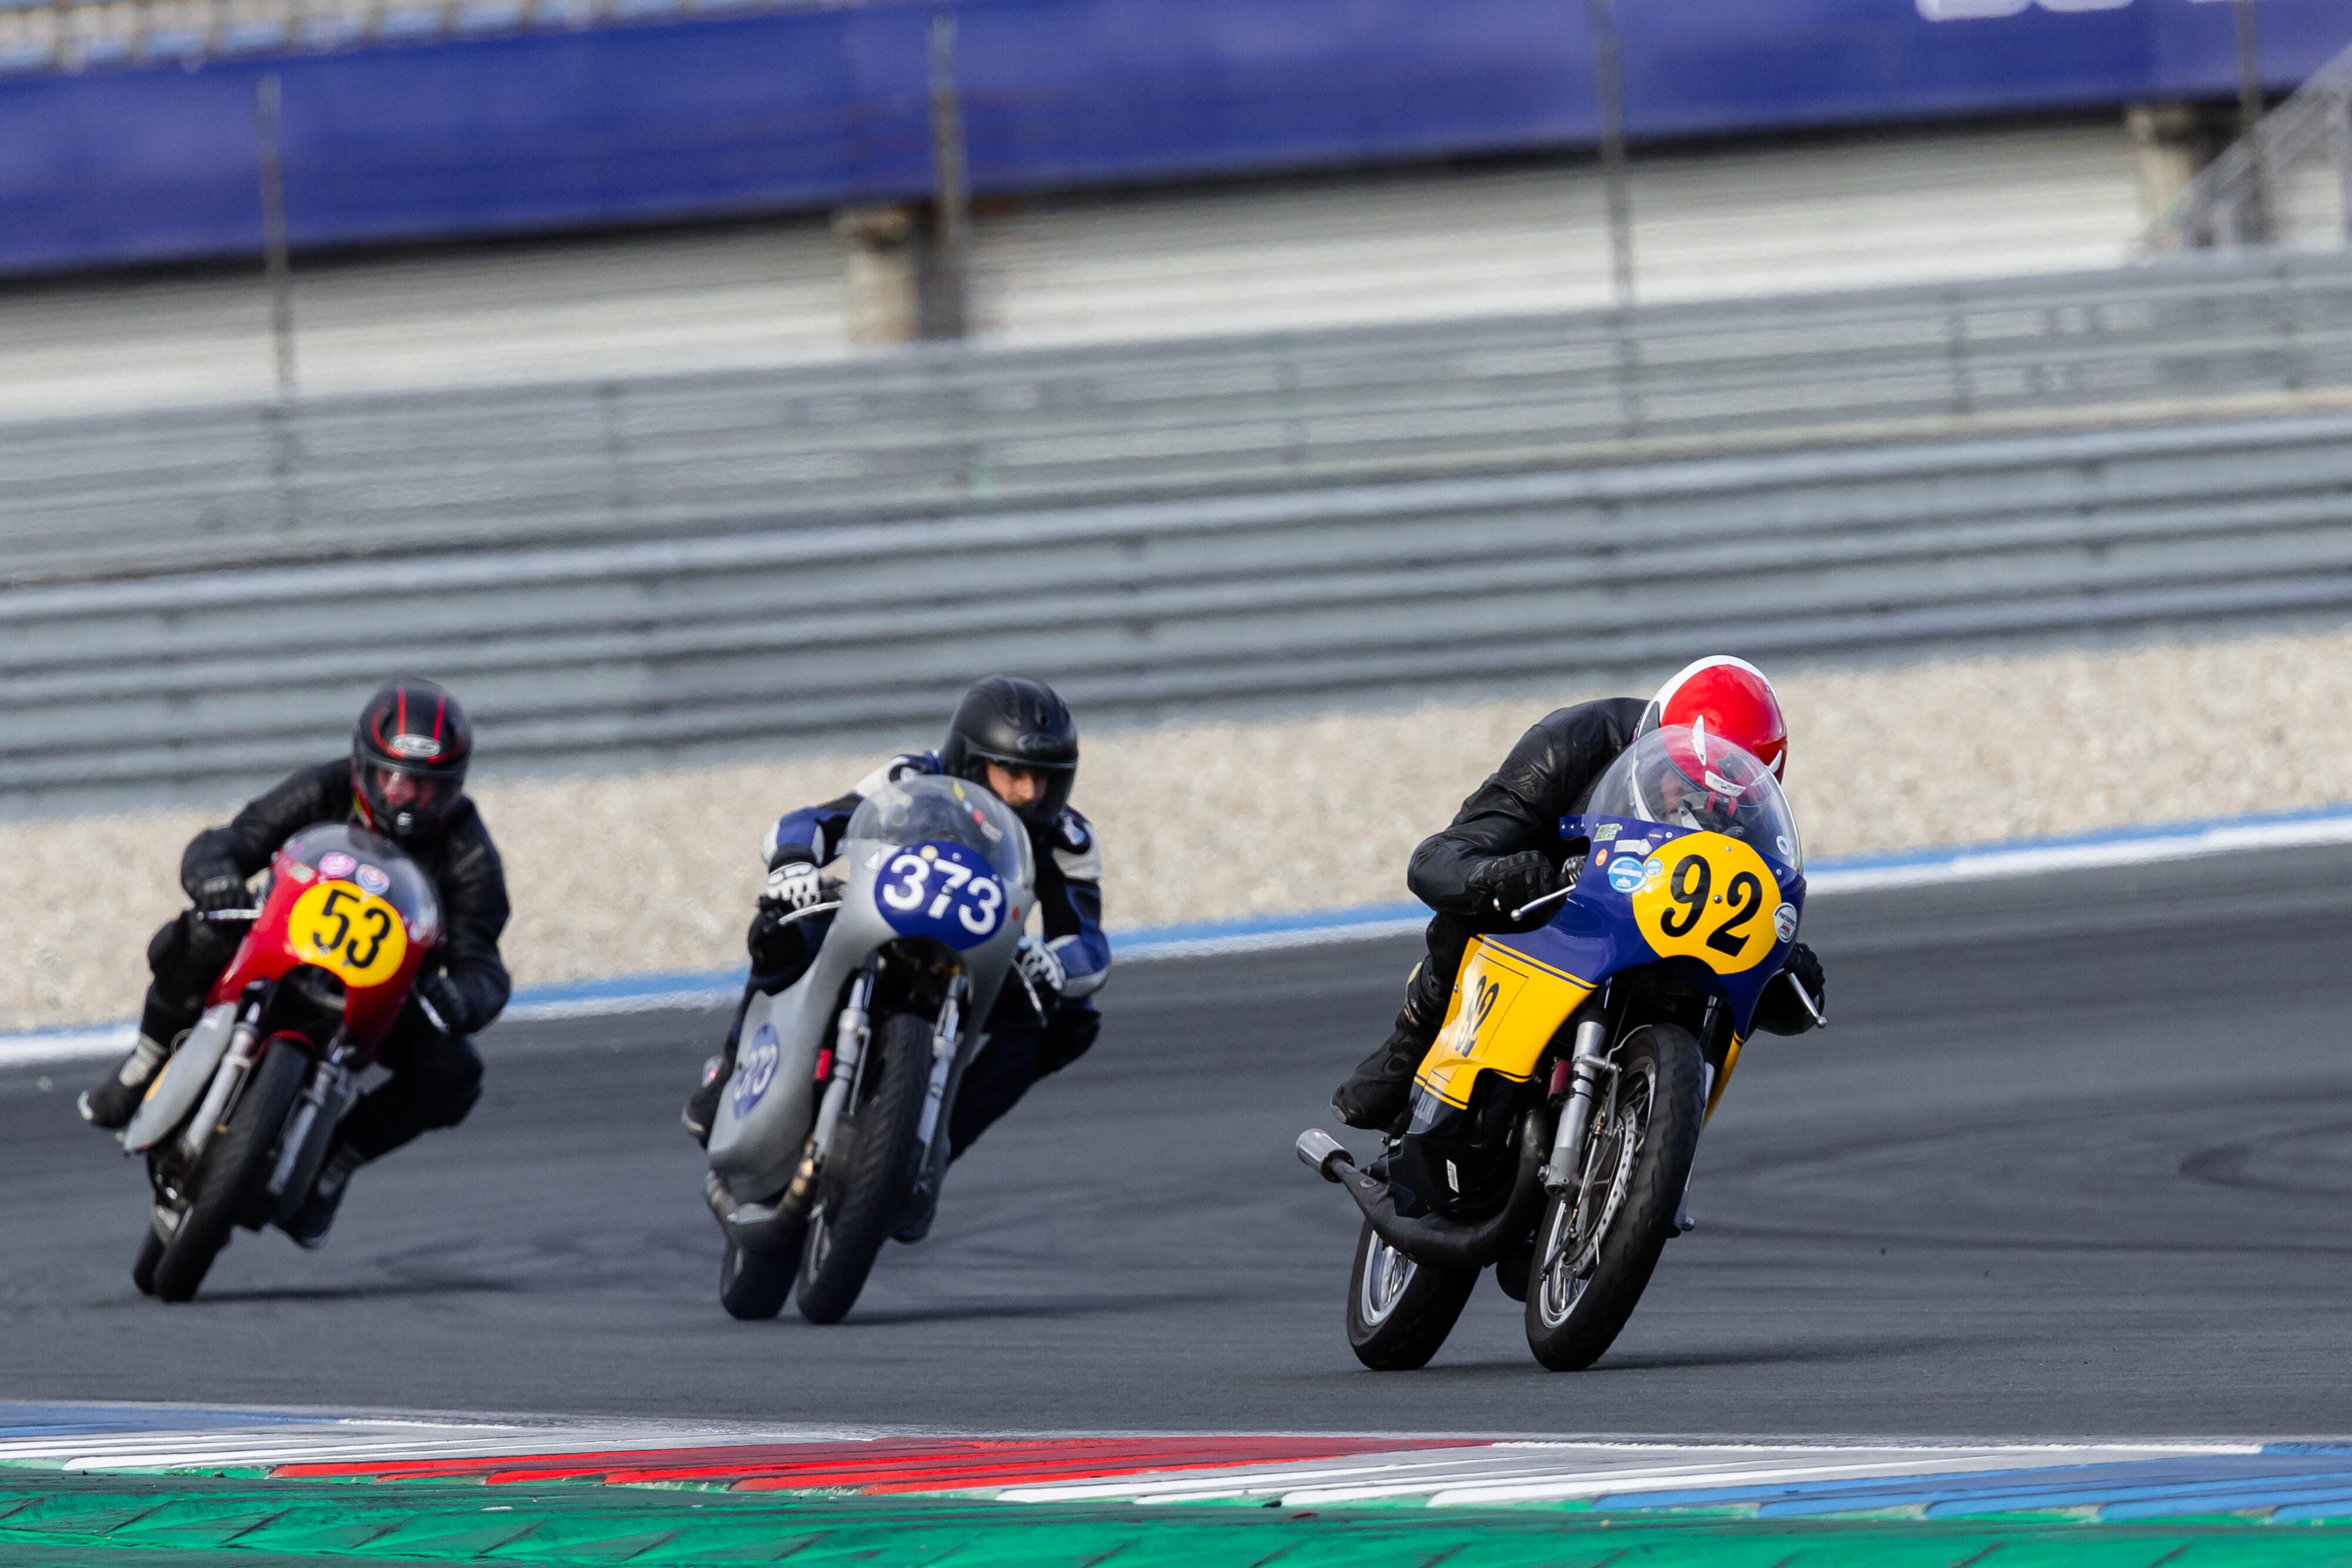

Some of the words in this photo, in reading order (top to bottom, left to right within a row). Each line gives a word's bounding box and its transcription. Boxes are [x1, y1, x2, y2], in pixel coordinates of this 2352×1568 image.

[312, 889, 390, 968] 53
[883, 855, 1002, 935] 373
[1661, 854, 1762, 957] 92
[1455, 975, 1499, 1058] 92
